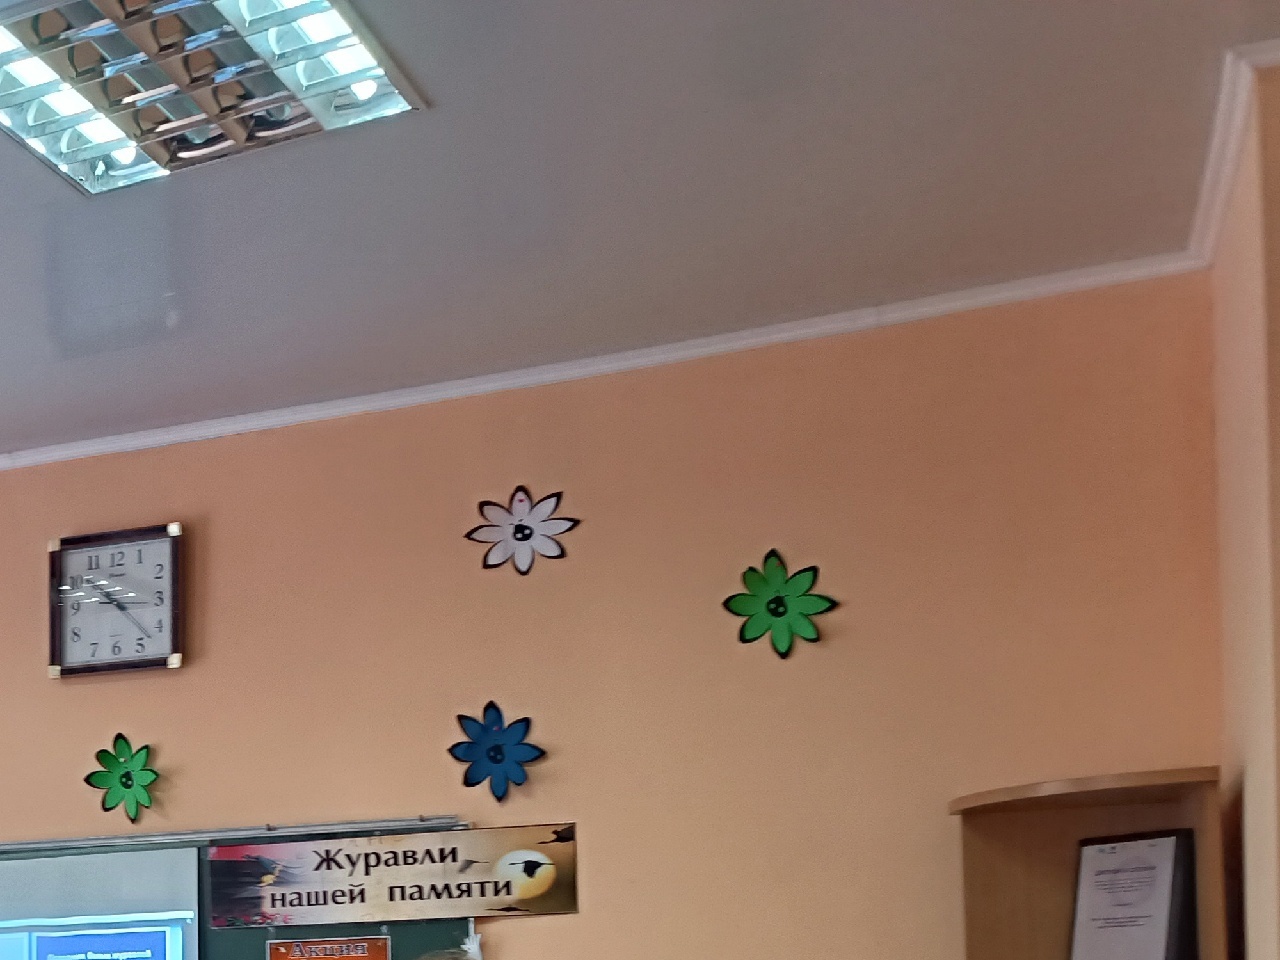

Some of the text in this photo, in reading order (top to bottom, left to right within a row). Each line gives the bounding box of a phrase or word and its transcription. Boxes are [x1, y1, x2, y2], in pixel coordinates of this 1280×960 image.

[87, 555, 100, 570] 11
[108, 551, 125, 568] 12
[136, 549, 143, 564] 1
[153, 563, 164, 579] 2
[69, 574, 84, 590] 10
[153, 590, 164, 607] 3
[71, 600, 80, 616] 9
[153, 618, 163, 633] 4
[71, 626, 81, 643] 8
[89, 642, 99, 658] 7
[111, 640, 122, 656] 6
[135, 637, 146, 653] 5
[312, 846, 458, 877] Журавли
[270, 880, 512, 908] нашей памяти
[289, 942, 368, 958] Акция
